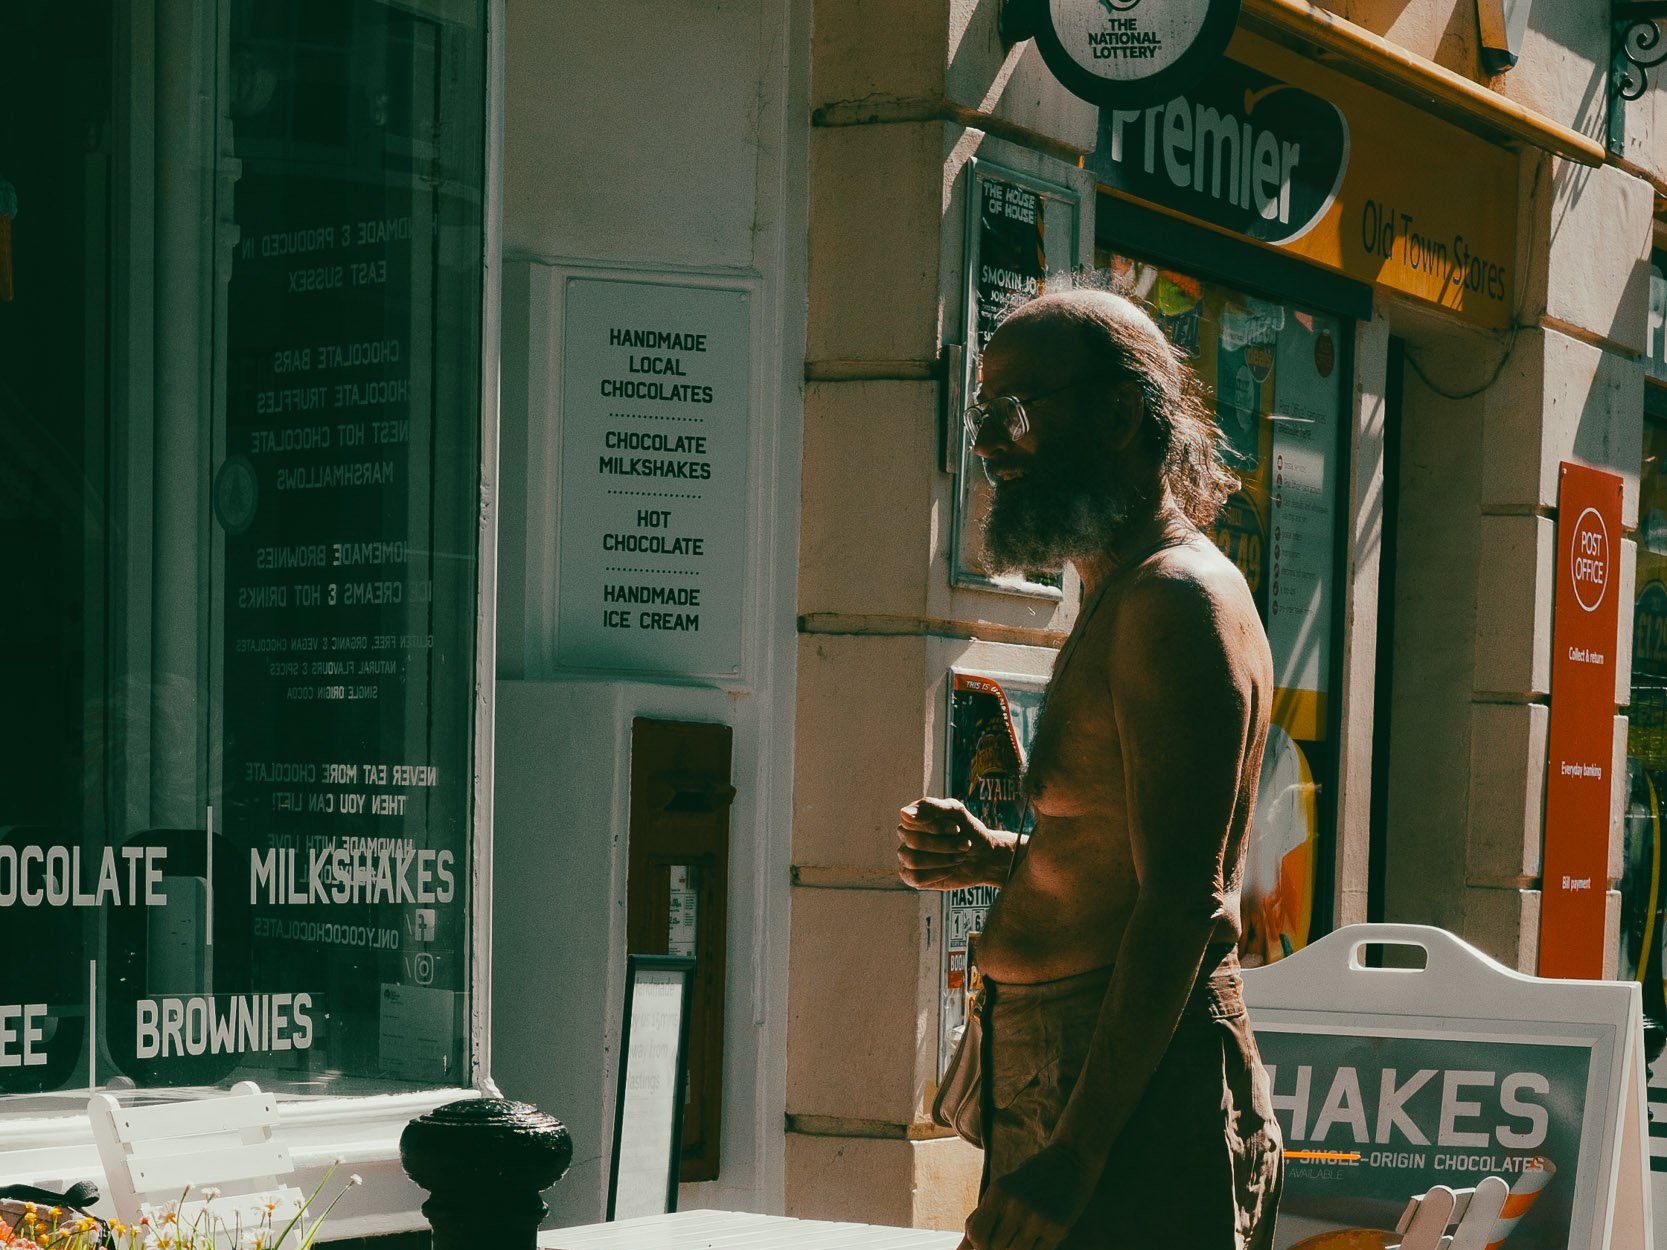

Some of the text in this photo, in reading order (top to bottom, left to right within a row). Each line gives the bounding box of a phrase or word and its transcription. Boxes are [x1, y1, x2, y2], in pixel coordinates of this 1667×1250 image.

[1108, 18, 1137, 31] THE
[1088, 31, 1161, 45] NATIONAL
[1093, 45, 1157, 59] LOTTERY
[1111, 95, 1300, 224] Premier
[983, 181, 1036, 210] THE HOUSE
[988, 199, 1035, 225] OF HOUSE
[1362, 199, 1505, 301] Old Town Stores
[982, 265, 1022, 290] SMOKIN
[609, 328, 707, 352] HANDMADE
[629, 355, 687, 376] LOCAL
[600, 379, 713, 404] CHOCOLATES
[605, 431, 707, 454] CHOCOLATE
[599, 456, 711, 480] MILKSHAKES
[637, 510, 672, 529] HOT
[603, 533, 704, 556] CHOCOLATE
[1581, 530, 1602, 557] POST
[1575, 556, 1604, 585] OFFICE
[603, 585, 700, 607] HANDMADE
[603, 610, 700, 632] ICE CREAM
[1568, 646, 1585, 663] Collect
[1589, 650, 1604, 665] return
[966, 680, 991, 691] THIS IS
[1561, 760, 1602, 781] Everyday banking
[0, 844, 168, 907] OCOLATE
[250, 847, 455, 905] MILKSHAKES
[0, 1003, 48, 1067] EE
[136, 992, 313, 1060] BROWNIES
[1433, 1152, 1545, 1173] CHOCOLATES
[1288, 1168, 1344, 1181] AVAILABLE
